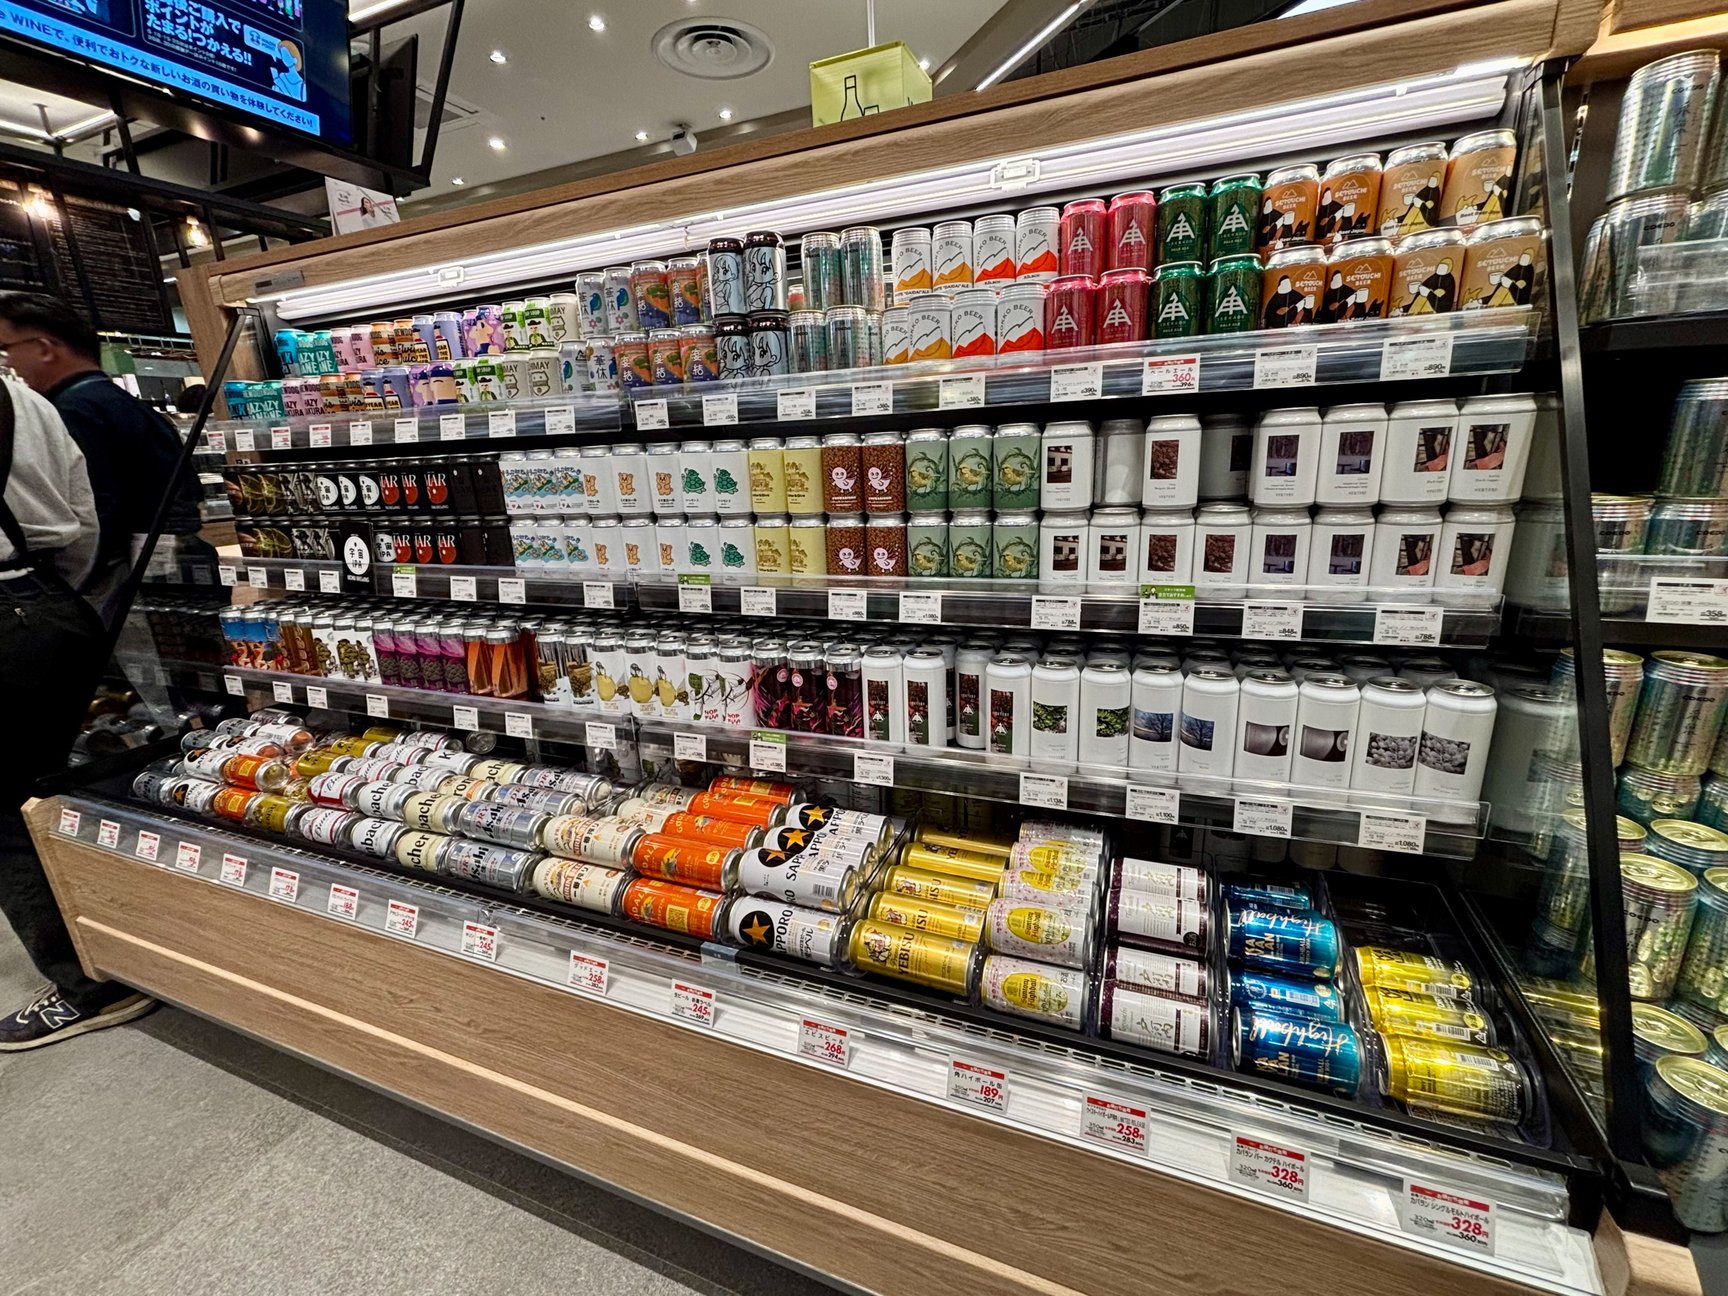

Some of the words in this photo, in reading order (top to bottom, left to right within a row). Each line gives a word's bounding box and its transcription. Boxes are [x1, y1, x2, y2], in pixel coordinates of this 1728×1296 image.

[989, 236, 1006, 245] BEER
[1029, 228, 1047, 238] BEER
[964, 310, 983, 320] BEER
[1014, 304, 1033, 315] BEER
[922, 315, 940, 325] BEER
[380, 550, 391, 558] IPA
[352, 559, 362, 568] IPA
[475, 805, 489, 831] DRY
[482, 802, 508, 839] Asahi
[573, 867, 588, 897] 一番搾り
[898, 932, 915, 975] YEBISU
[1021, 977, 1030, 1004] Suntory
[1027, 977, 1037, 1009] Highball
[804, 1028, 844, 1045] エビスビール
[824, 1041, 845, 1055] 268円
[954, 1071, 1003, 1090] 角ハイボール缶
[980, 1085, 1003, 1101] 189円
[1116, 1123, 1145, 1140] 258円
[1272, 1166, 1304, 1186] 328円
[1410, 1197, 1430, 1209] カバラン
[1431, 1202, 1490, 1224] シングルモルトハイボール
[1452, 1216, 1489, 1239] 328円
